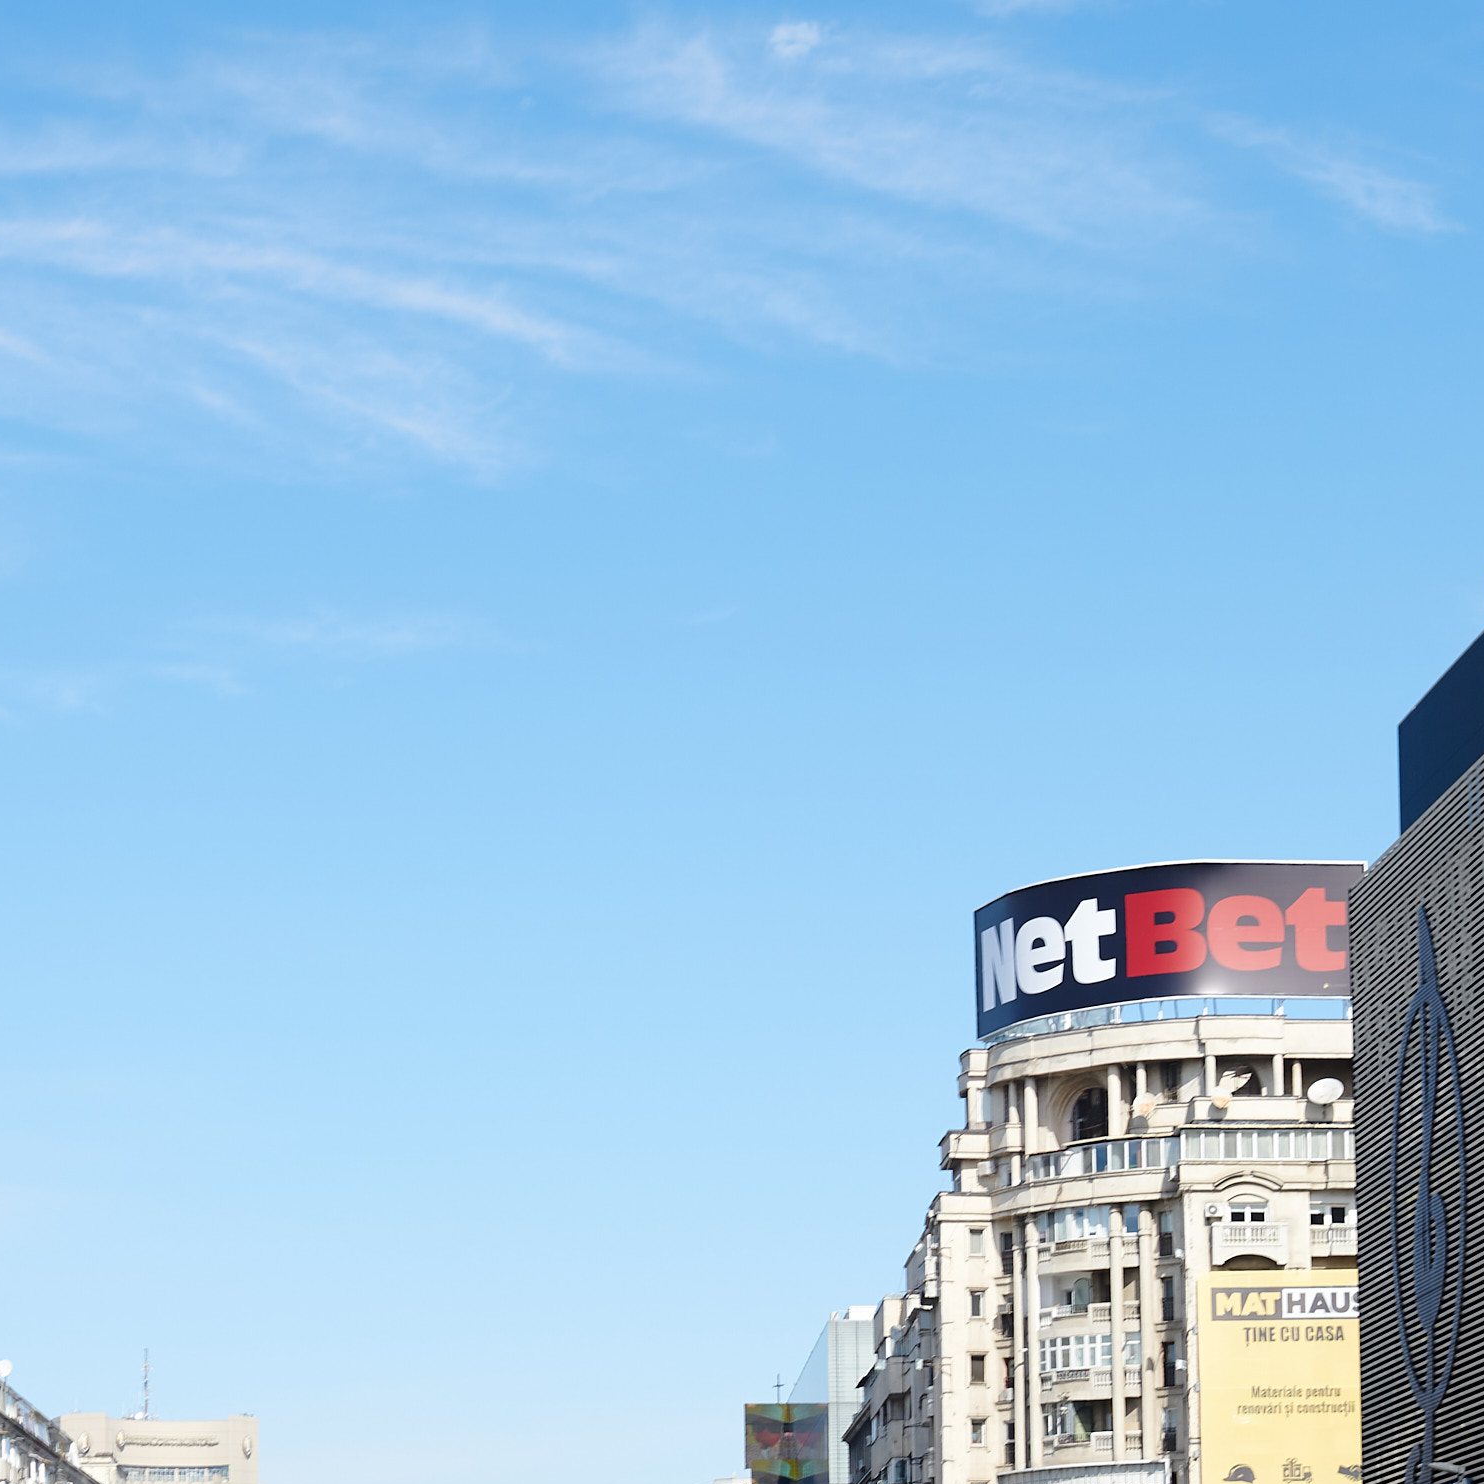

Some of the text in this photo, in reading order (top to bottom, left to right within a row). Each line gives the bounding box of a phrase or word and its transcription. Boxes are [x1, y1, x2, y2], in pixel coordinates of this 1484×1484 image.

[981, 887, 1347, 1013] NetBet
[1280, 1326, 1300, 1341] CU
[1305, 1326, 1345, 1341] CASA
[1251, 1385, 1341, 1399] Materiale pentru
